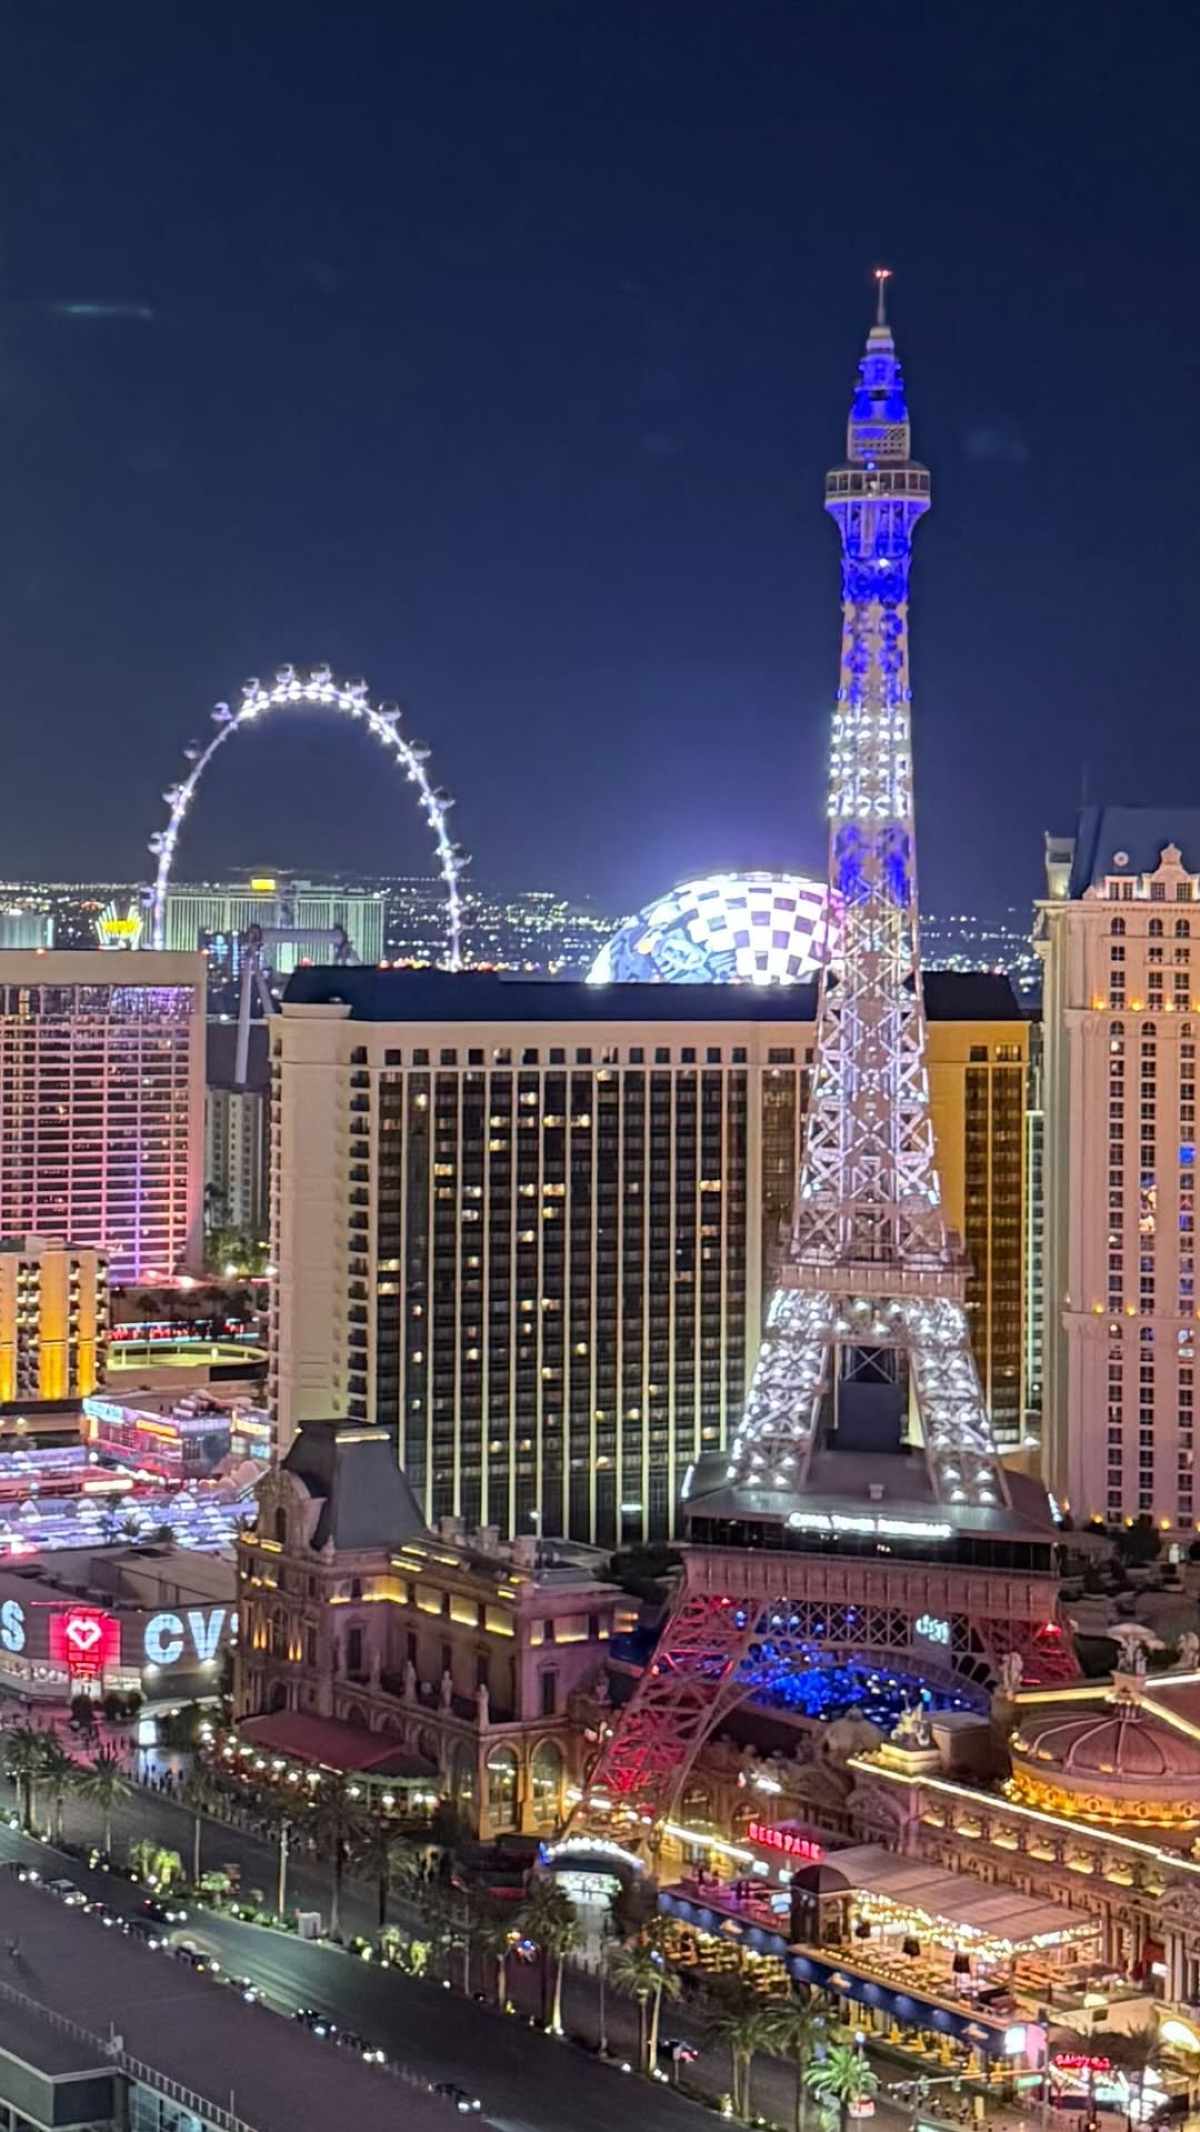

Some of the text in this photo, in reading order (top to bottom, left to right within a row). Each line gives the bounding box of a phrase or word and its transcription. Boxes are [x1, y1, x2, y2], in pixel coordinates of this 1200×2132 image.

[144, 1609, 239, 1664] CV
[749, 1821, 820, 1860] BEER PARK
